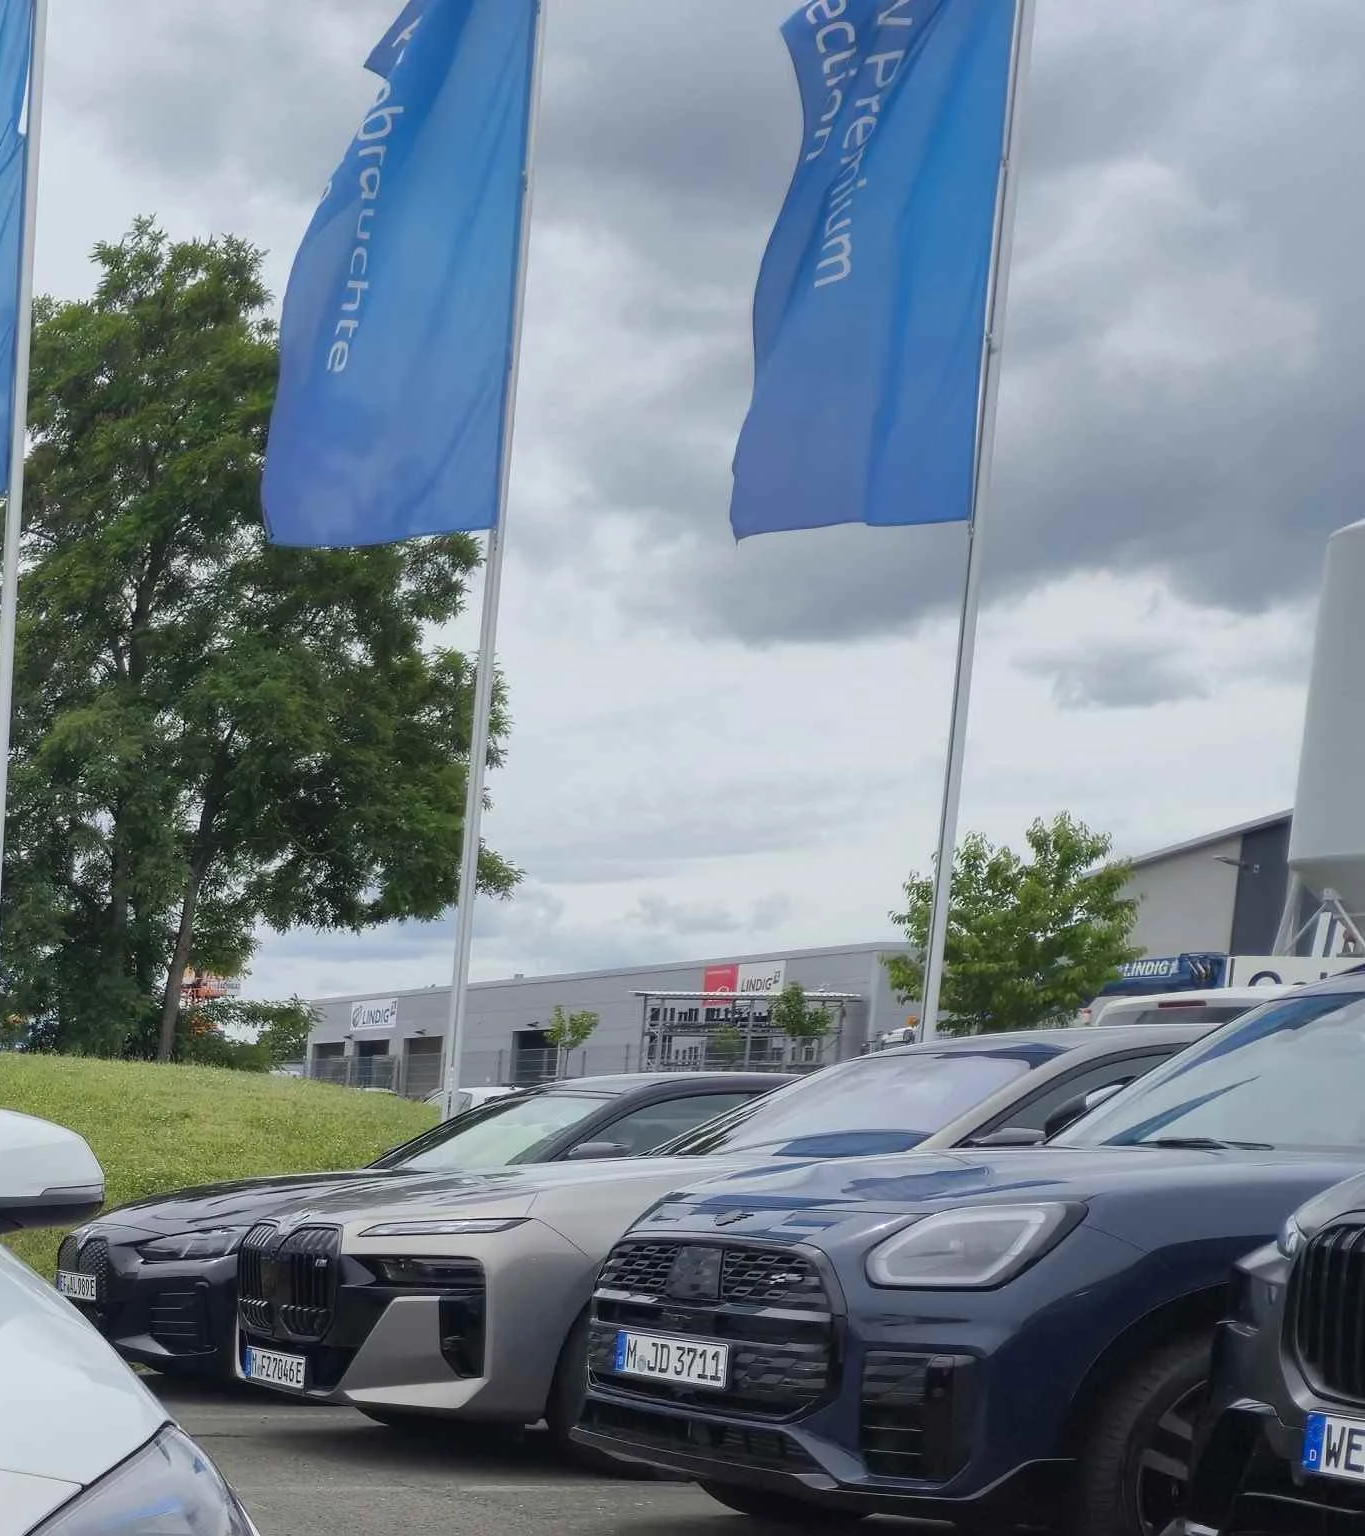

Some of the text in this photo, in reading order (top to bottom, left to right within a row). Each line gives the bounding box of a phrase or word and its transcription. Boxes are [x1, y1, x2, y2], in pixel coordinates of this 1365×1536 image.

[806, 0, 858, 161] ection
[740, 978, 773, 993] LINDIG
[362, 1008, 390, 1025] LINDIG
[626, 1338, 721, 1381] M JD 3711
